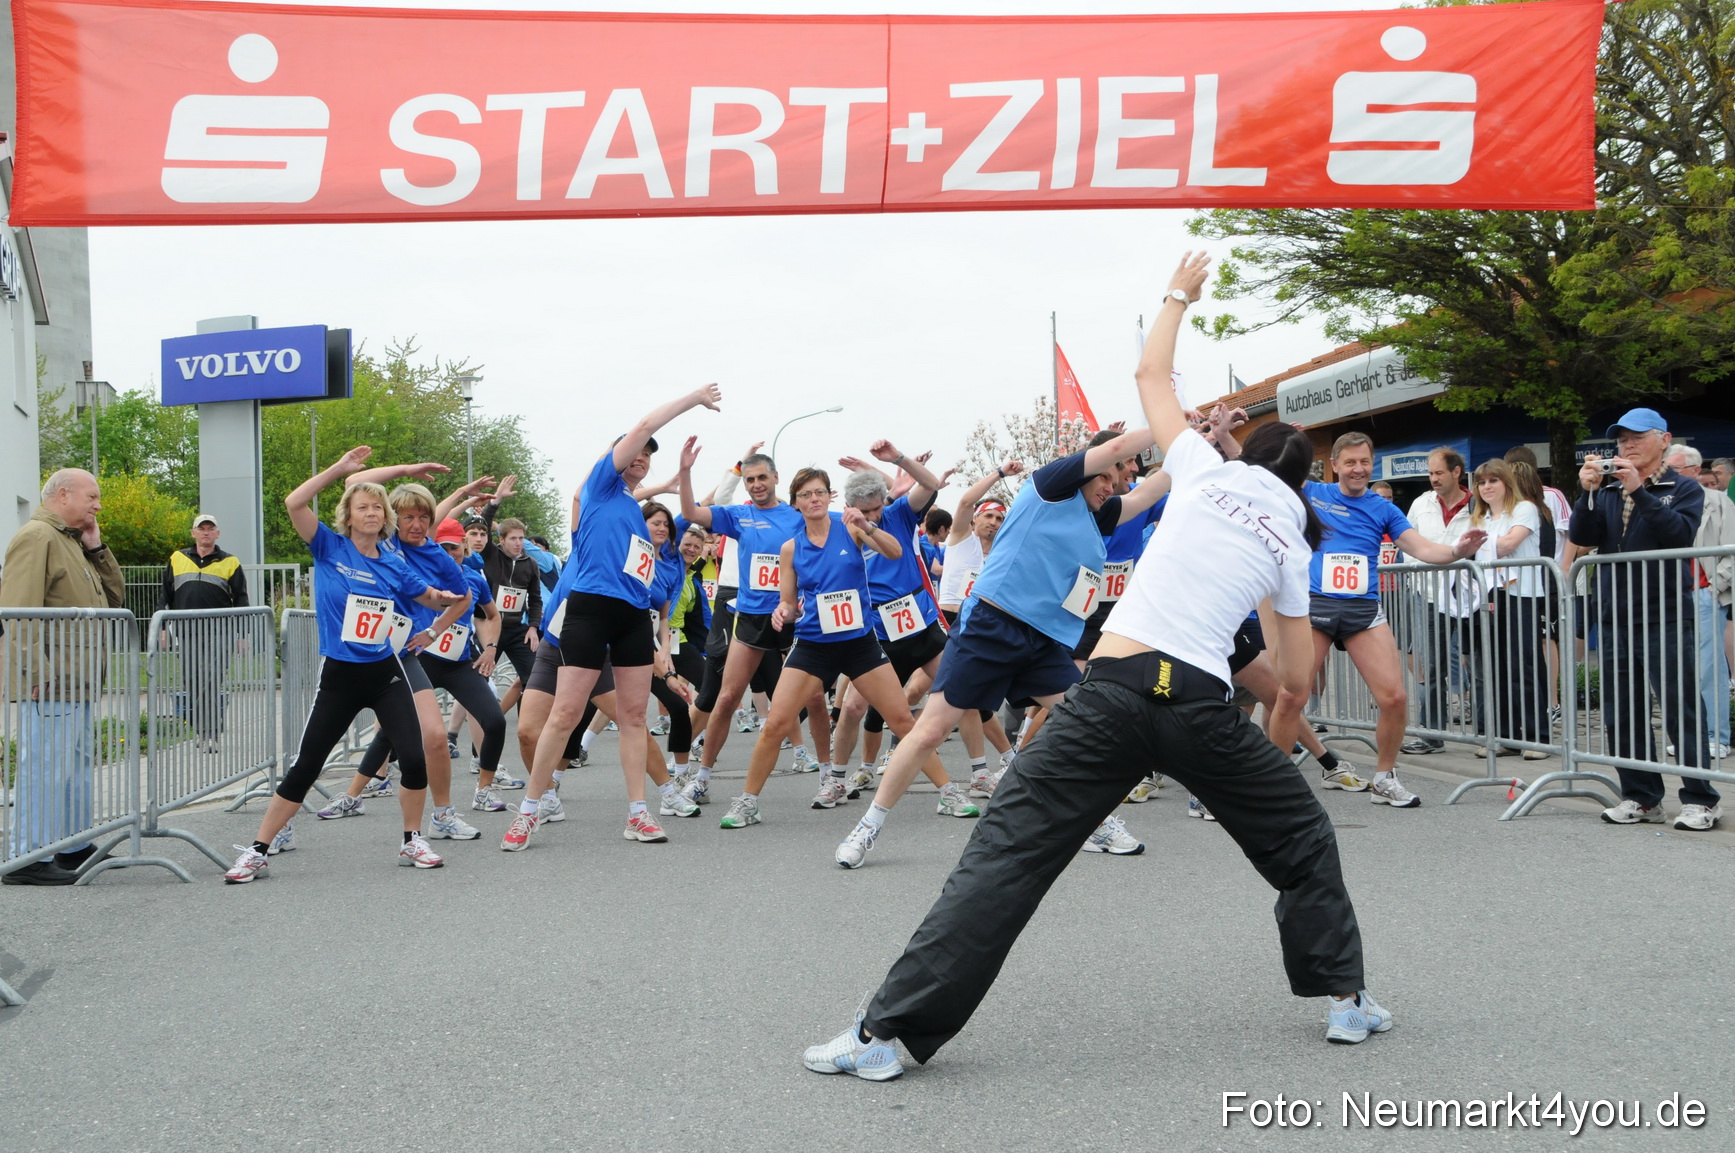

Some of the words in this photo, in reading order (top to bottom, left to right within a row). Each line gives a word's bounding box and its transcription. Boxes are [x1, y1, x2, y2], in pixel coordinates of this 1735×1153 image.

[175, 348, 301, 380] VOLVO
[1286, 388, 1333, 414] Autohaus
[1335, 370, 1382, 399] Gerhart
[1385, 364, 1397, 385] &
[1201, 484, 1288, 566] ZEITLOS
[638, 538, 653, 551] MEYER
[636, 552, 653, 581] 21
[1382, 551, 1397, 565] 57
[758, 566, 780, 588] 64
[1106, 574, 1126, 597] 16
[1332, 566, 1359, 590] 66
[356, 598, 379, 607] MEYER
[502, 594, 517, 610] 81
[823, 593, 844, 601] MEYER
[885, 601, 903, 611] MEYER
[1082, 587, 1096, 613] 1
[355, 611, 384, 640] 67
[831, 602, 854, 627] 10
[891, 609, 916, 634] 73
[439, 632, 454, 653] 6
